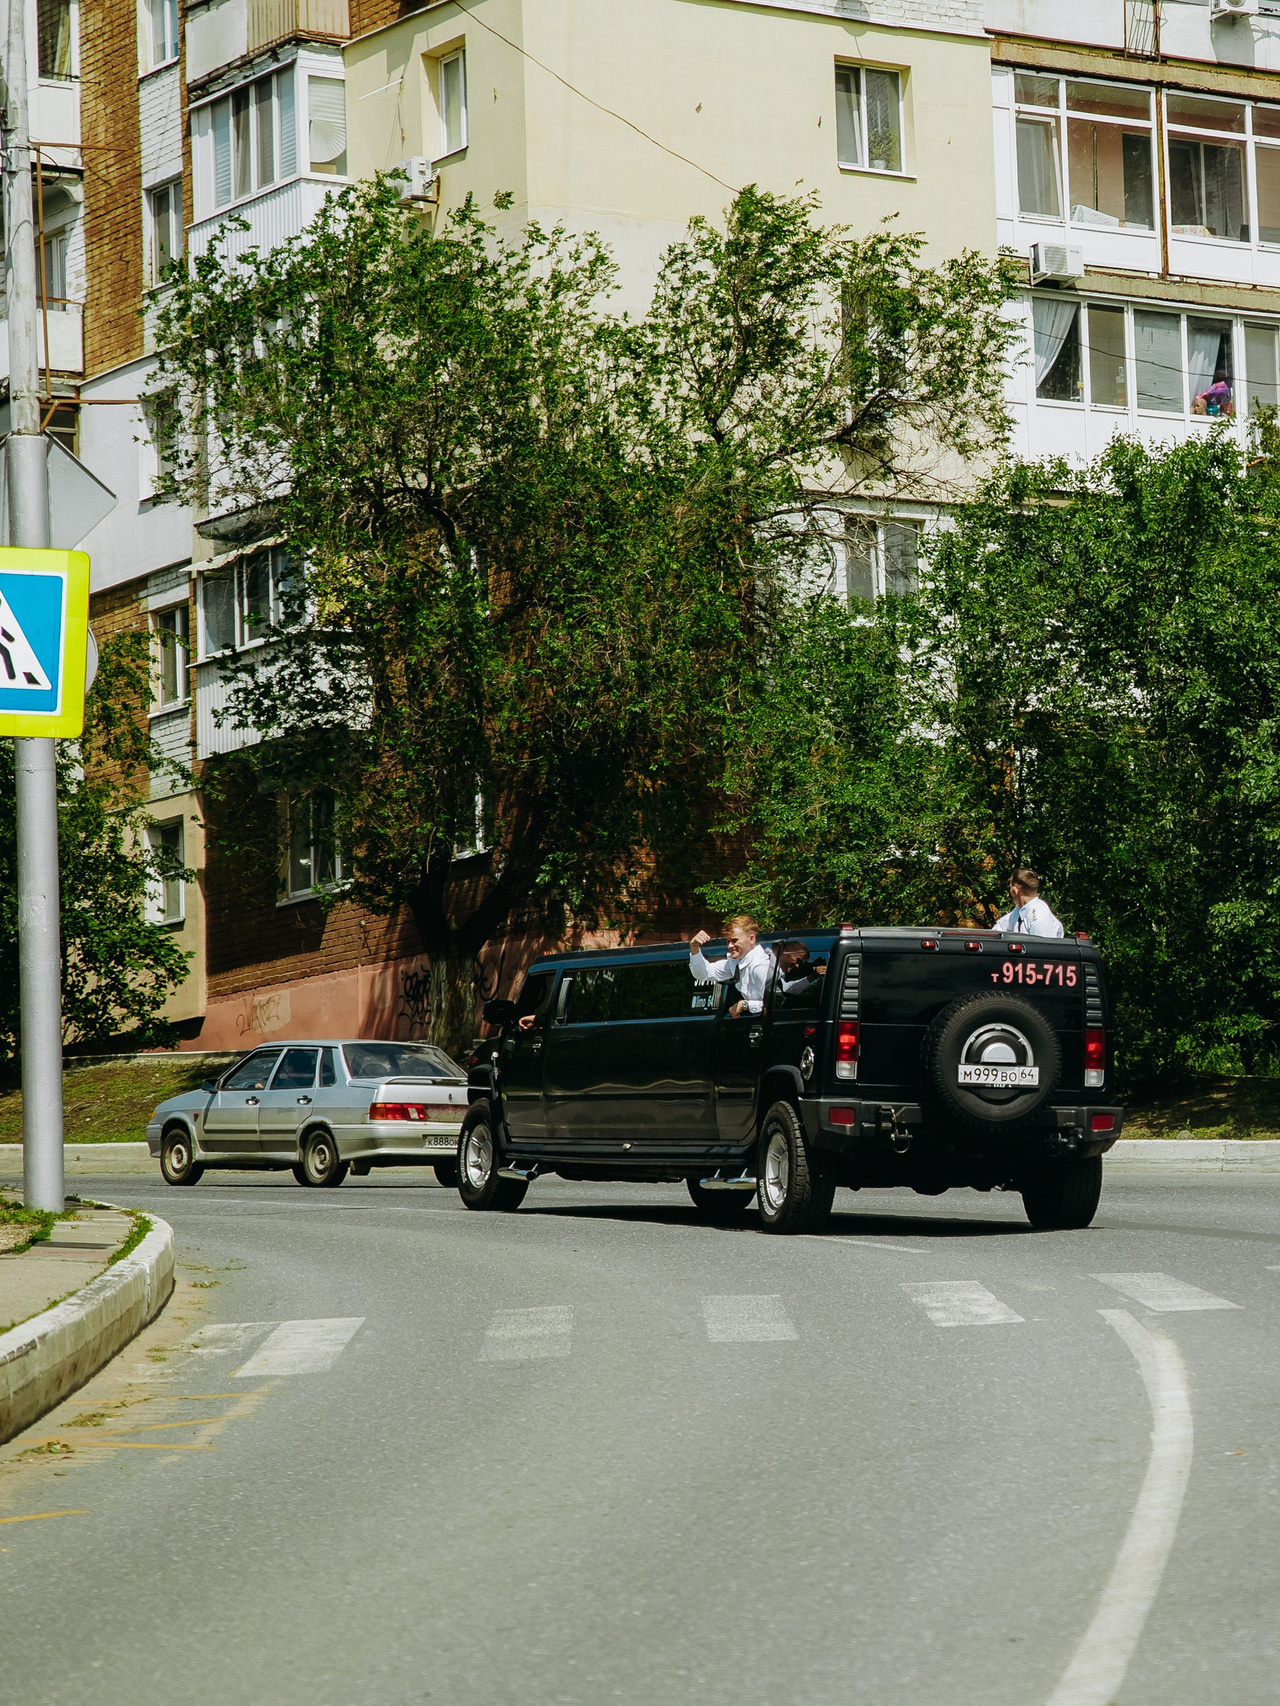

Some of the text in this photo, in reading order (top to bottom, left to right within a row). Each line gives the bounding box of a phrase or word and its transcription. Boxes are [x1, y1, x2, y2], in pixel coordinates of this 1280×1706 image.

[1002, 962, 1077, 986] 915-715
[963, 1068, 1034, 1082] М999ВО 64
